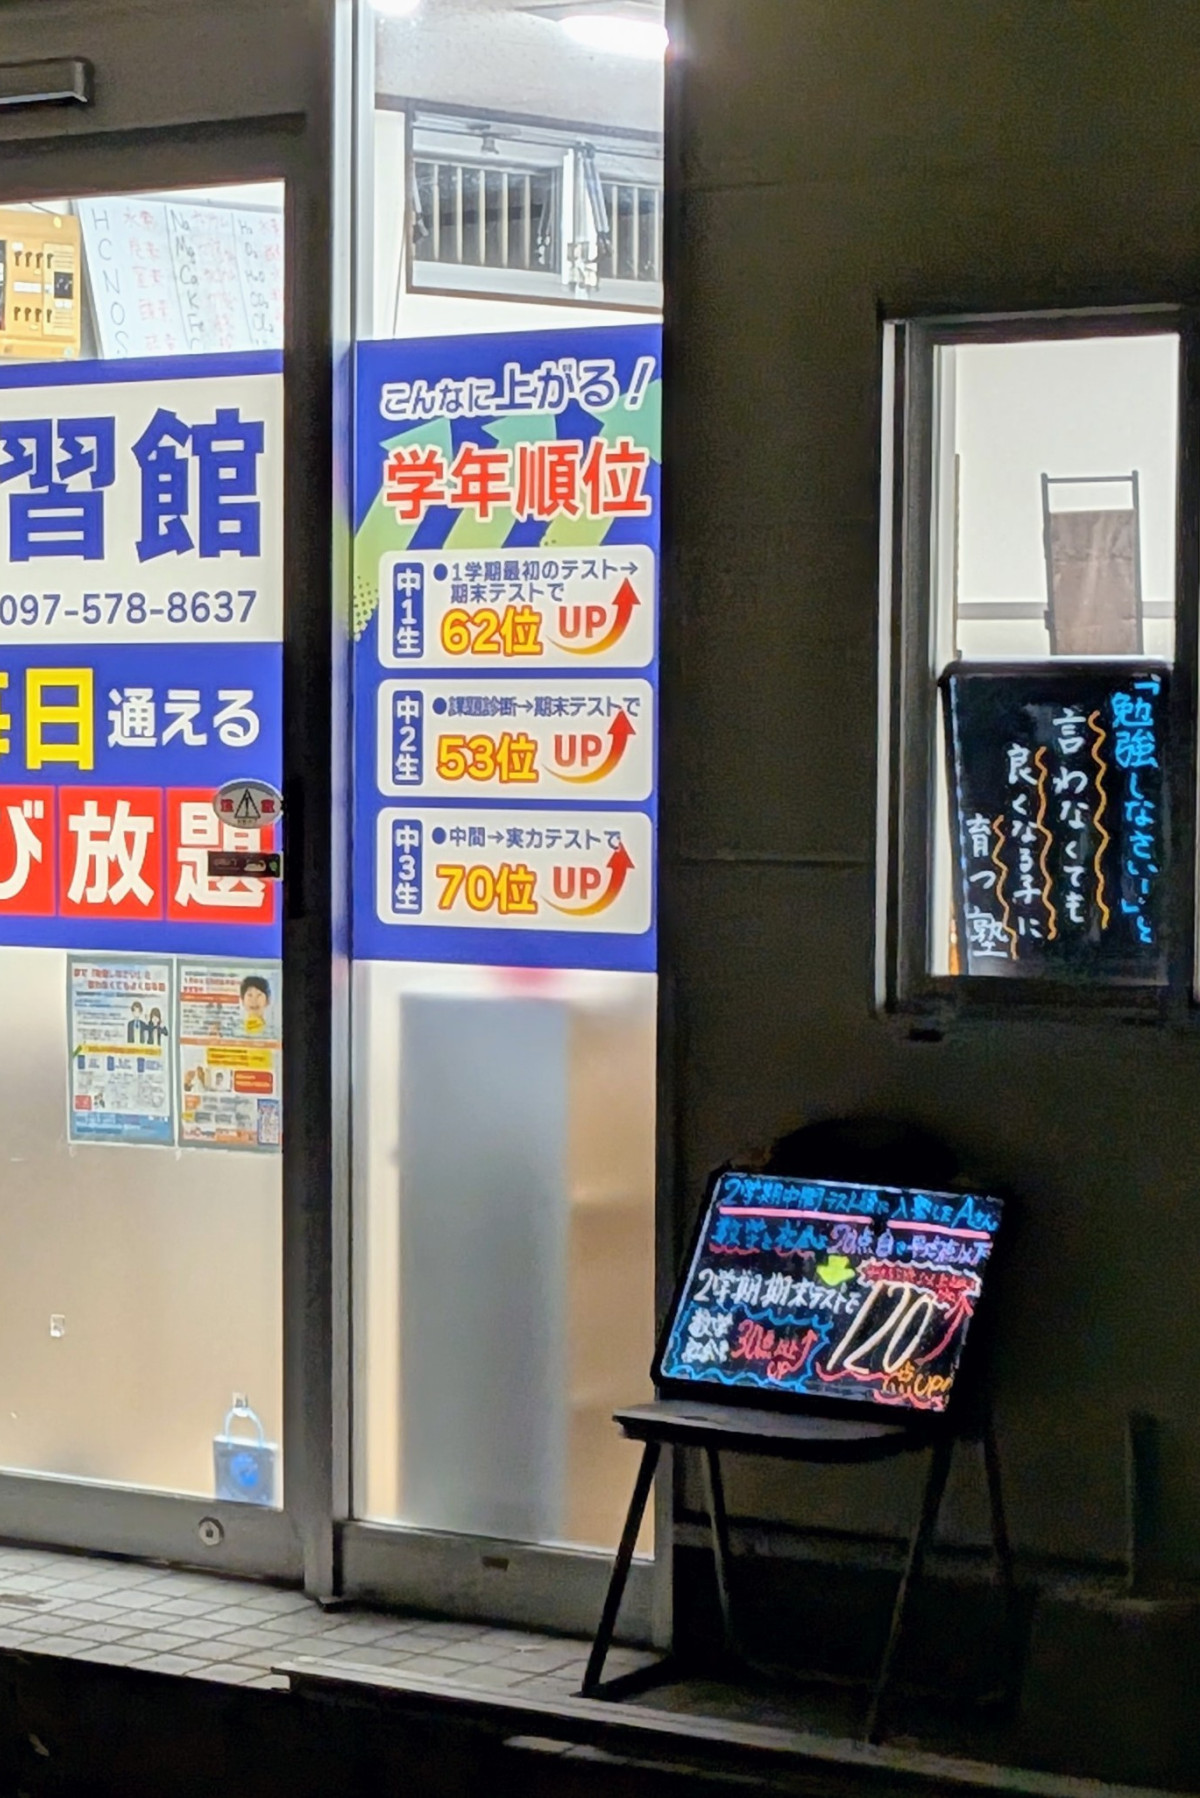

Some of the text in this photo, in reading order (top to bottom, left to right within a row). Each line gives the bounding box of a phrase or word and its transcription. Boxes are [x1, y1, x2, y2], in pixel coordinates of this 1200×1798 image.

[385, 441, 648, 520] 学年順位
[396, 566, 422, 655] 中1生
[440, 604, 607, 657] 62位 UP
[450, 582, 564, 604] 期末テストで
[396, 695, 420, 782] 中2生
[436, 731, 603, 784] 53位 UP
[1053, 707, 1089, 924] 言わなくても
[395, 824, 420, 911] 中3生
[435, 862, 601, 915] 70位 UP
